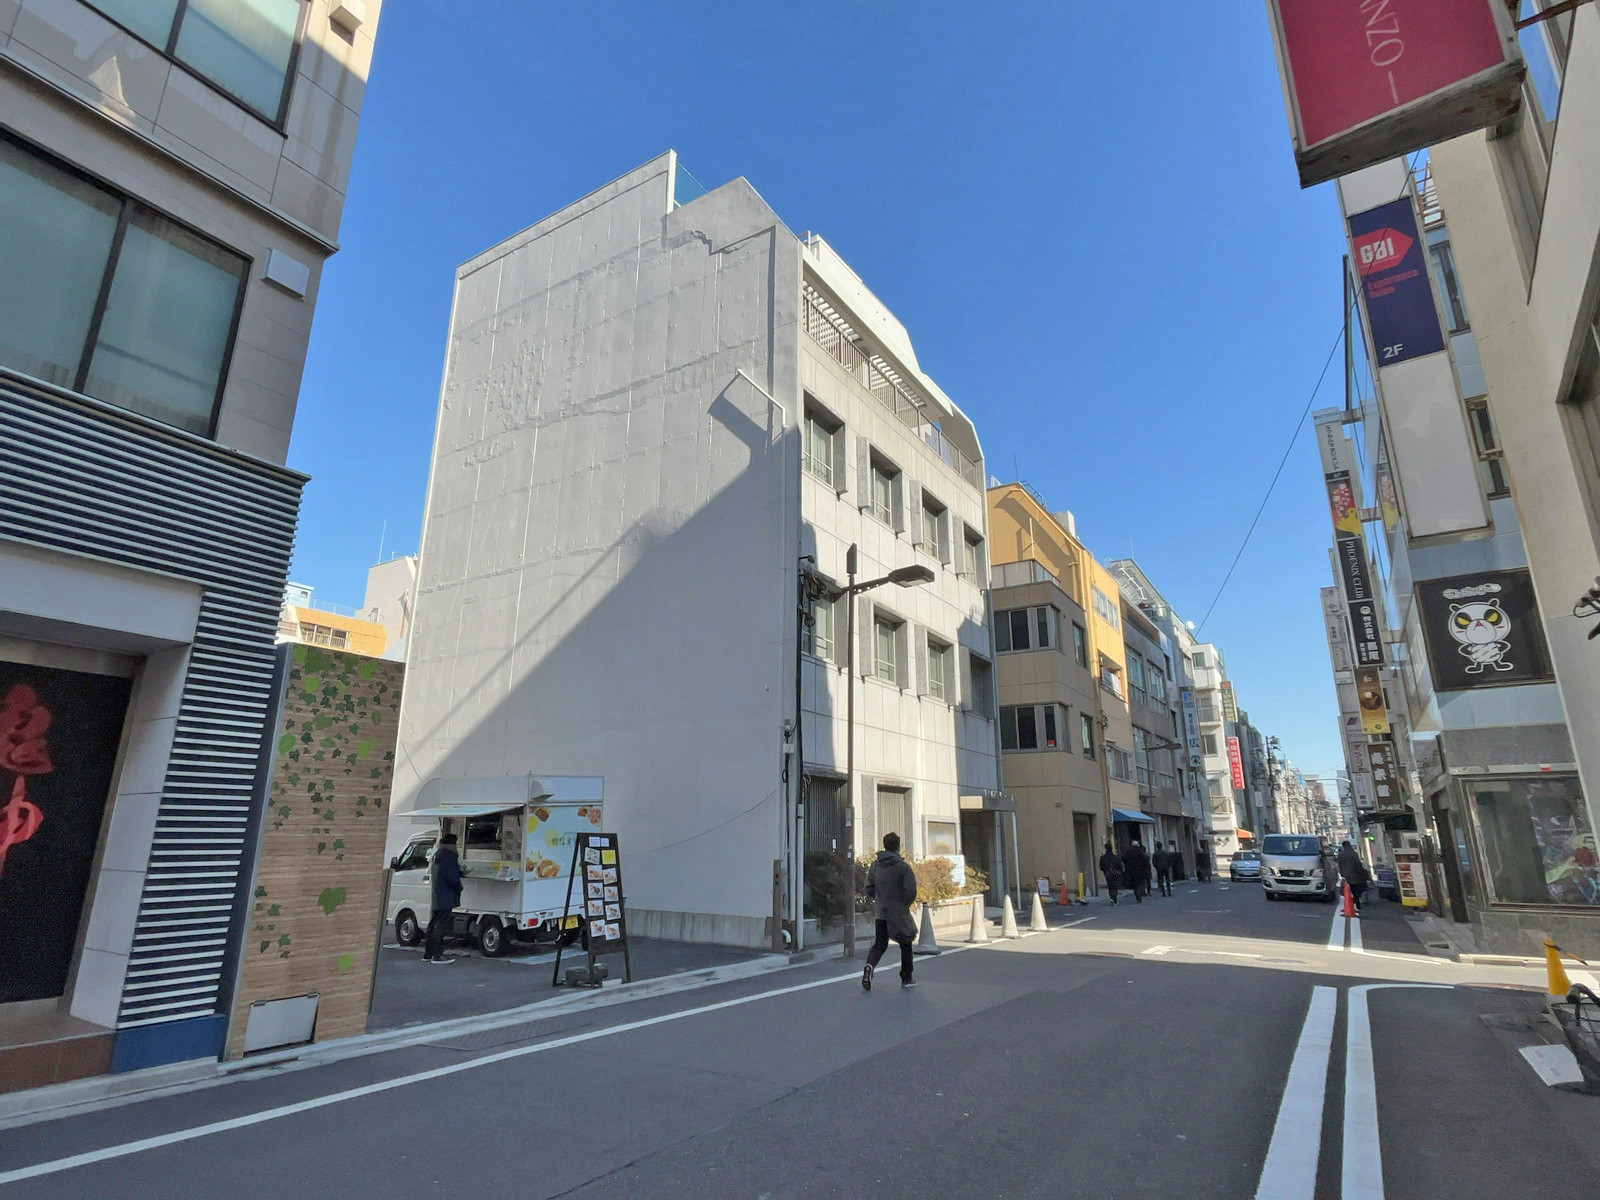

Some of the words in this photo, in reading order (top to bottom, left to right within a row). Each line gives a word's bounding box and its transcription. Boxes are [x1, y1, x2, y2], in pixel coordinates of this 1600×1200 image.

[1360, 0, 1404, 66] NZO
[1383, 343, 1404, 358] 2F
[1346, 541, 1360, 576] PHOENIX
[1353, 578, 1364, 598] CLUB
